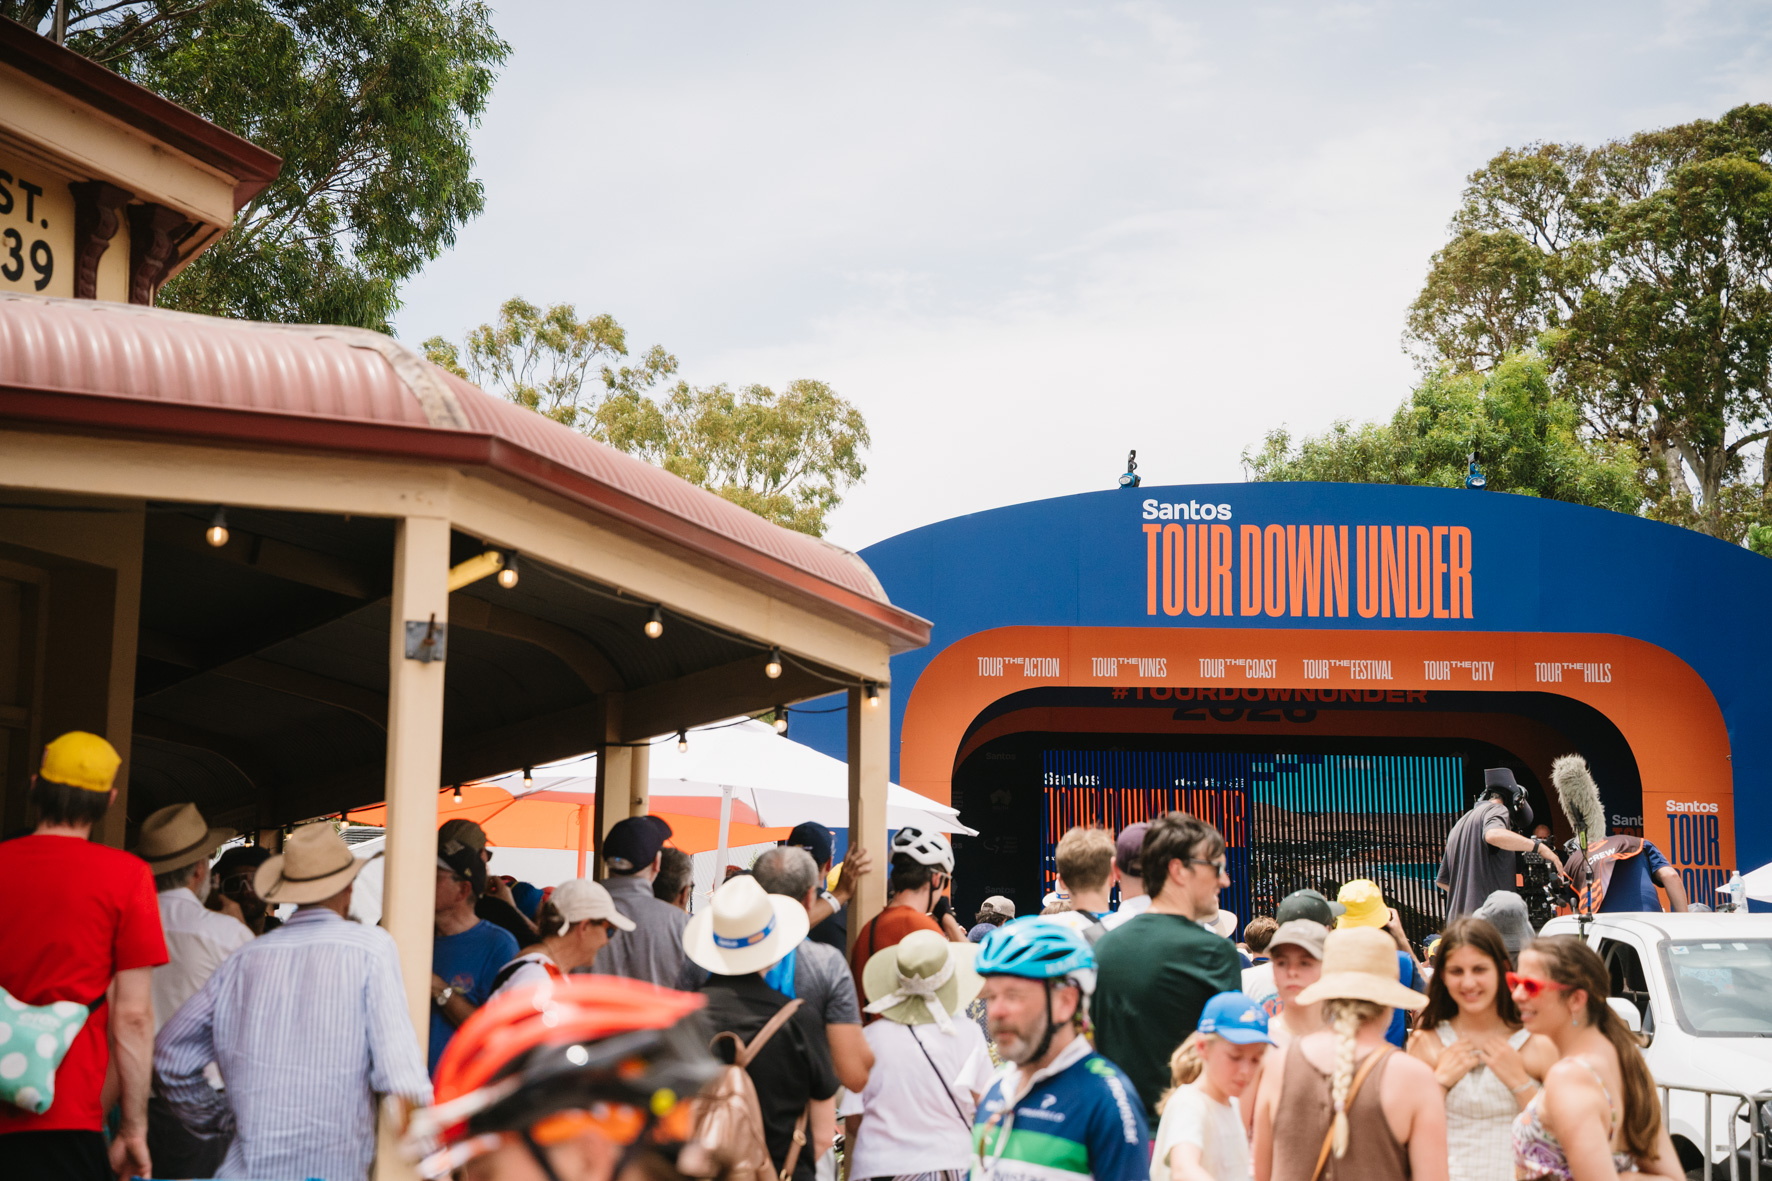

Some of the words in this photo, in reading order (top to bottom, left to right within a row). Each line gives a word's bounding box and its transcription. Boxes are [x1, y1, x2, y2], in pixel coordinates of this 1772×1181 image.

[2, 228, 54, 292] 39
[1142, 498, 1233, 521] Santos
[1142, 523, 1234, 617] TOUR
[1240, 524, 1349, 618] DOWN
[1356, 525, 1475, 619] UNDER
[977, 657, 1003, 676] TOUR
[1024, 658, 1060, 677] ACTION
[1092, 658, 1118, 677] TOUR
[1139, 658, 1167, 677] VINES
[1199, 659, 1225, 678] TOUR
[1246, 659, 1277, 678] COAST
[1303, 660, 1329, 679] TOUR
[1350, 660, 1393, 679] FESTIVAL
[1424, 661, 1450, 680] TOUR
[1472, 661, 1494, 681] CITY
[1535, 663, 1562, 682] TOUR
[1584, 663, 1612, 683] HILLS
[1666, 800, 1719, 813] Santos
[1667, 814, 1720, 866] TOUR
[1588, 847, 1616, 865] CREW
[1671, 868, 1731, 912] OWN
